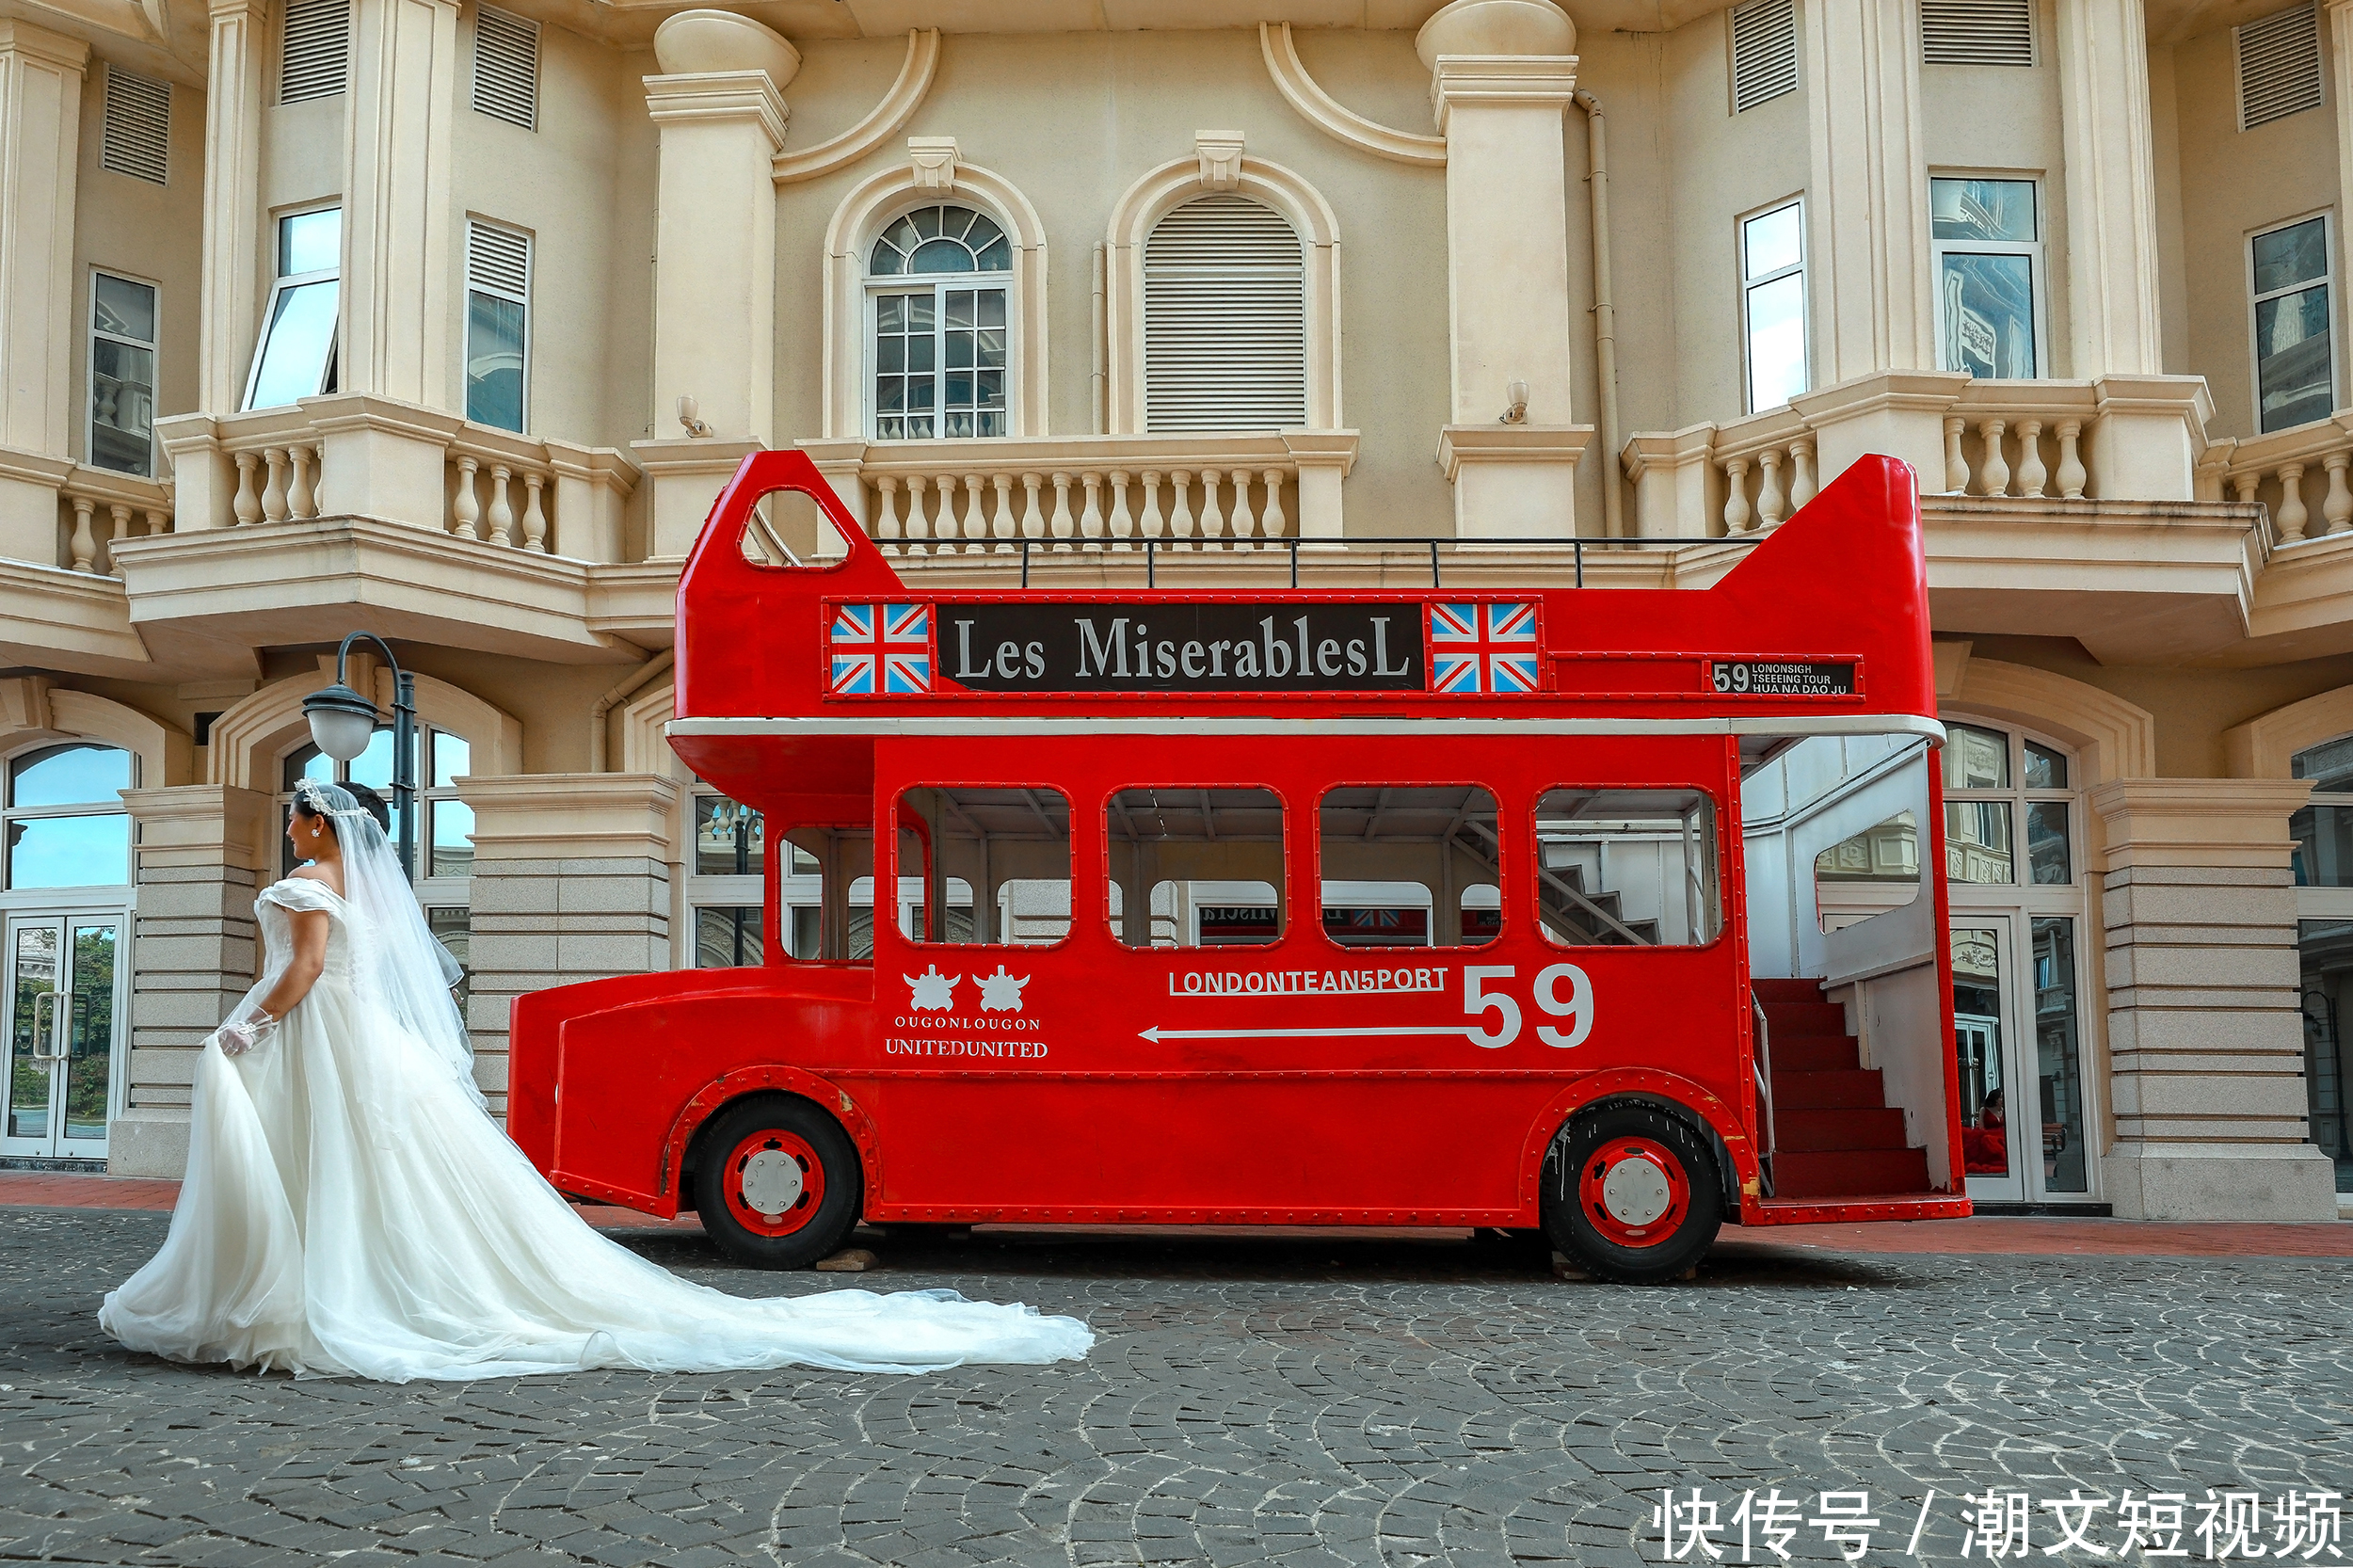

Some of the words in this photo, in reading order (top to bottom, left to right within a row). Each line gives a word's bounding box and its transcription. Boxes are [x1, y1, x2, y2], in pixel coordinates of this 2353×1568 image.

[954, 619, 1046, 679] Les
[1074, 615, 1410, 679] MiserablesL
[1752, 664, 1812, 674] LONONSIGH
[1713, 664, 1749, 693] 59
[1752, 674, 1801, 684] TSEEEING
[1802, 675, 1831, 685] TOUR
[1753, 684, 1780, 694] HUA
[1782, 684, 1800, 694] NA
[1801, 684, 1829, 695] DAO
[1831, 685, 1847, 695] JU
[1464, 963, 1594, 1049] 59
[894, 1016, 1040, 1031] OUGONLOUGON
[885, 1038, 1048, 1059] UNITEDUNITED
